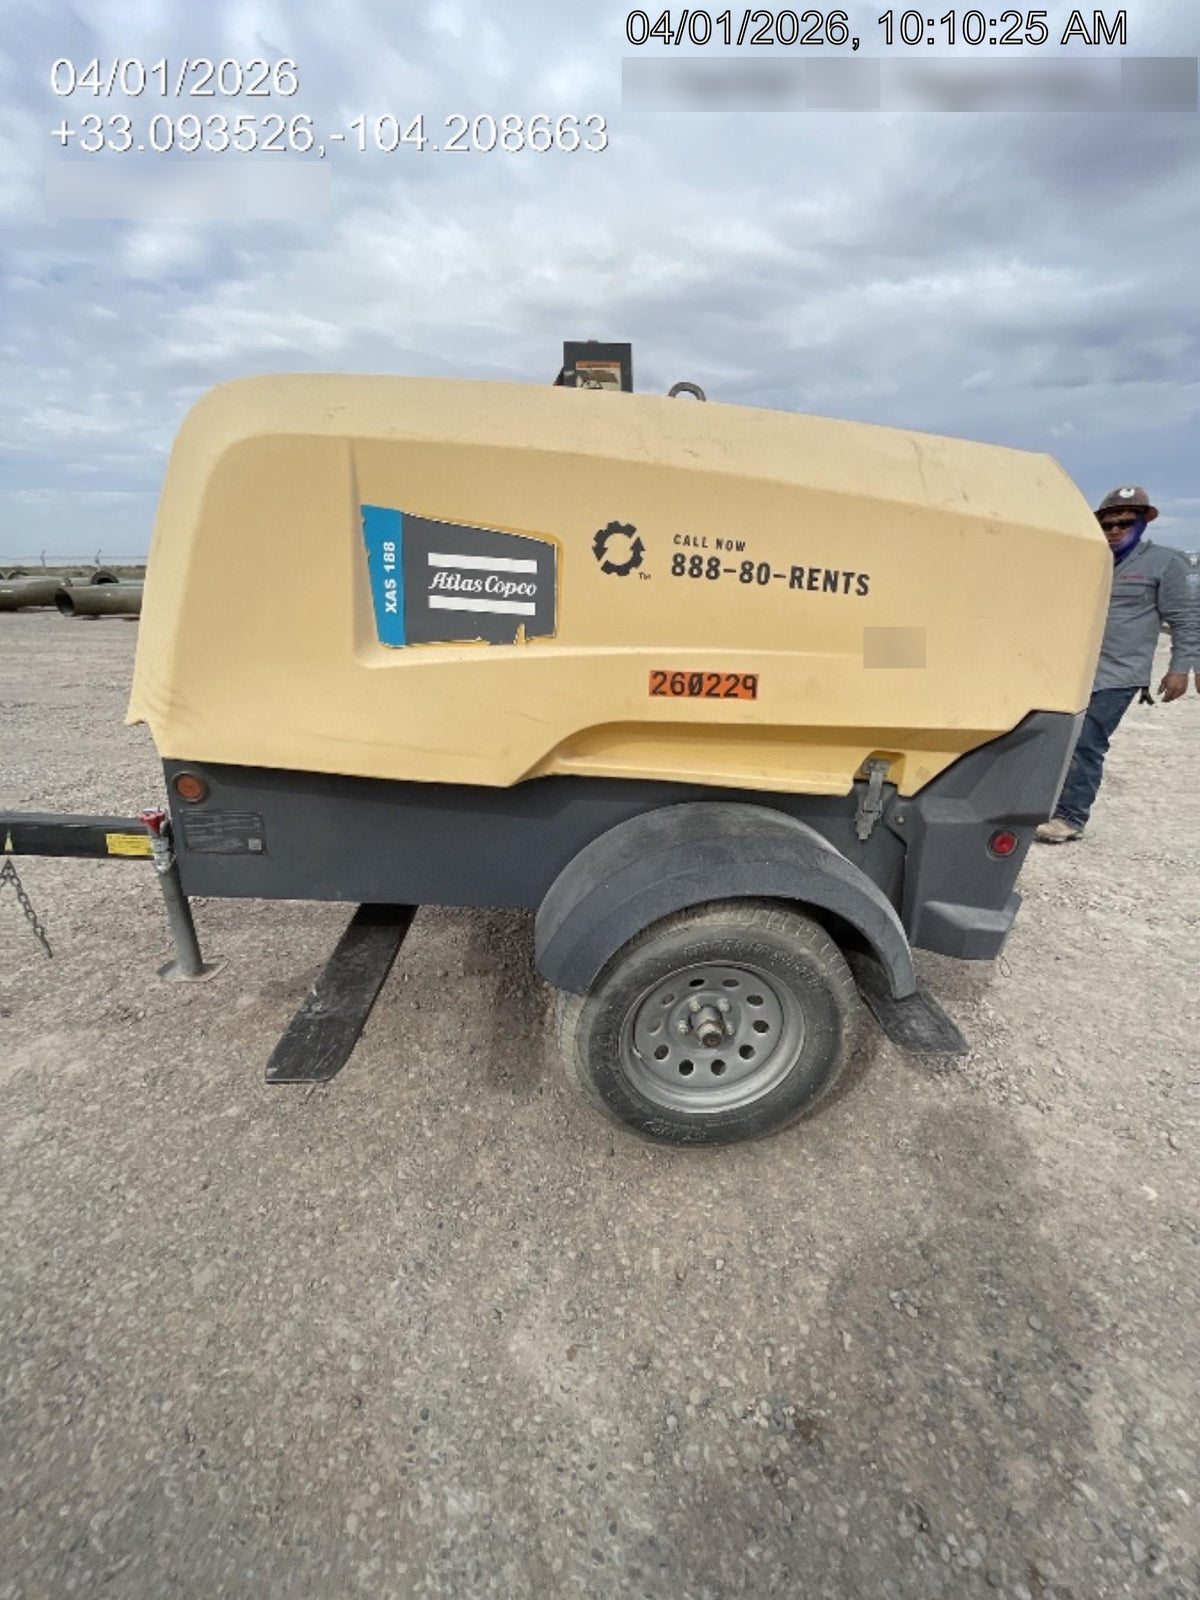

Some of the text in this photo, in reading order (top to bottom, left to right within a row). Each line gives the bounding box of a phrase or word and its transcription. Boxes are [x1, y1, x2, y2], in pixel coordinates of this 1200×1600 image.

[673, 534, 746, 552] CALL NOW
[382, 541, 397, 613] XAS 188
[428, 571, 537, 598] Atlas Copco
[671, 553, 870, 596] 888-80-RENTS
[651, 671, 757, 698] 260229
